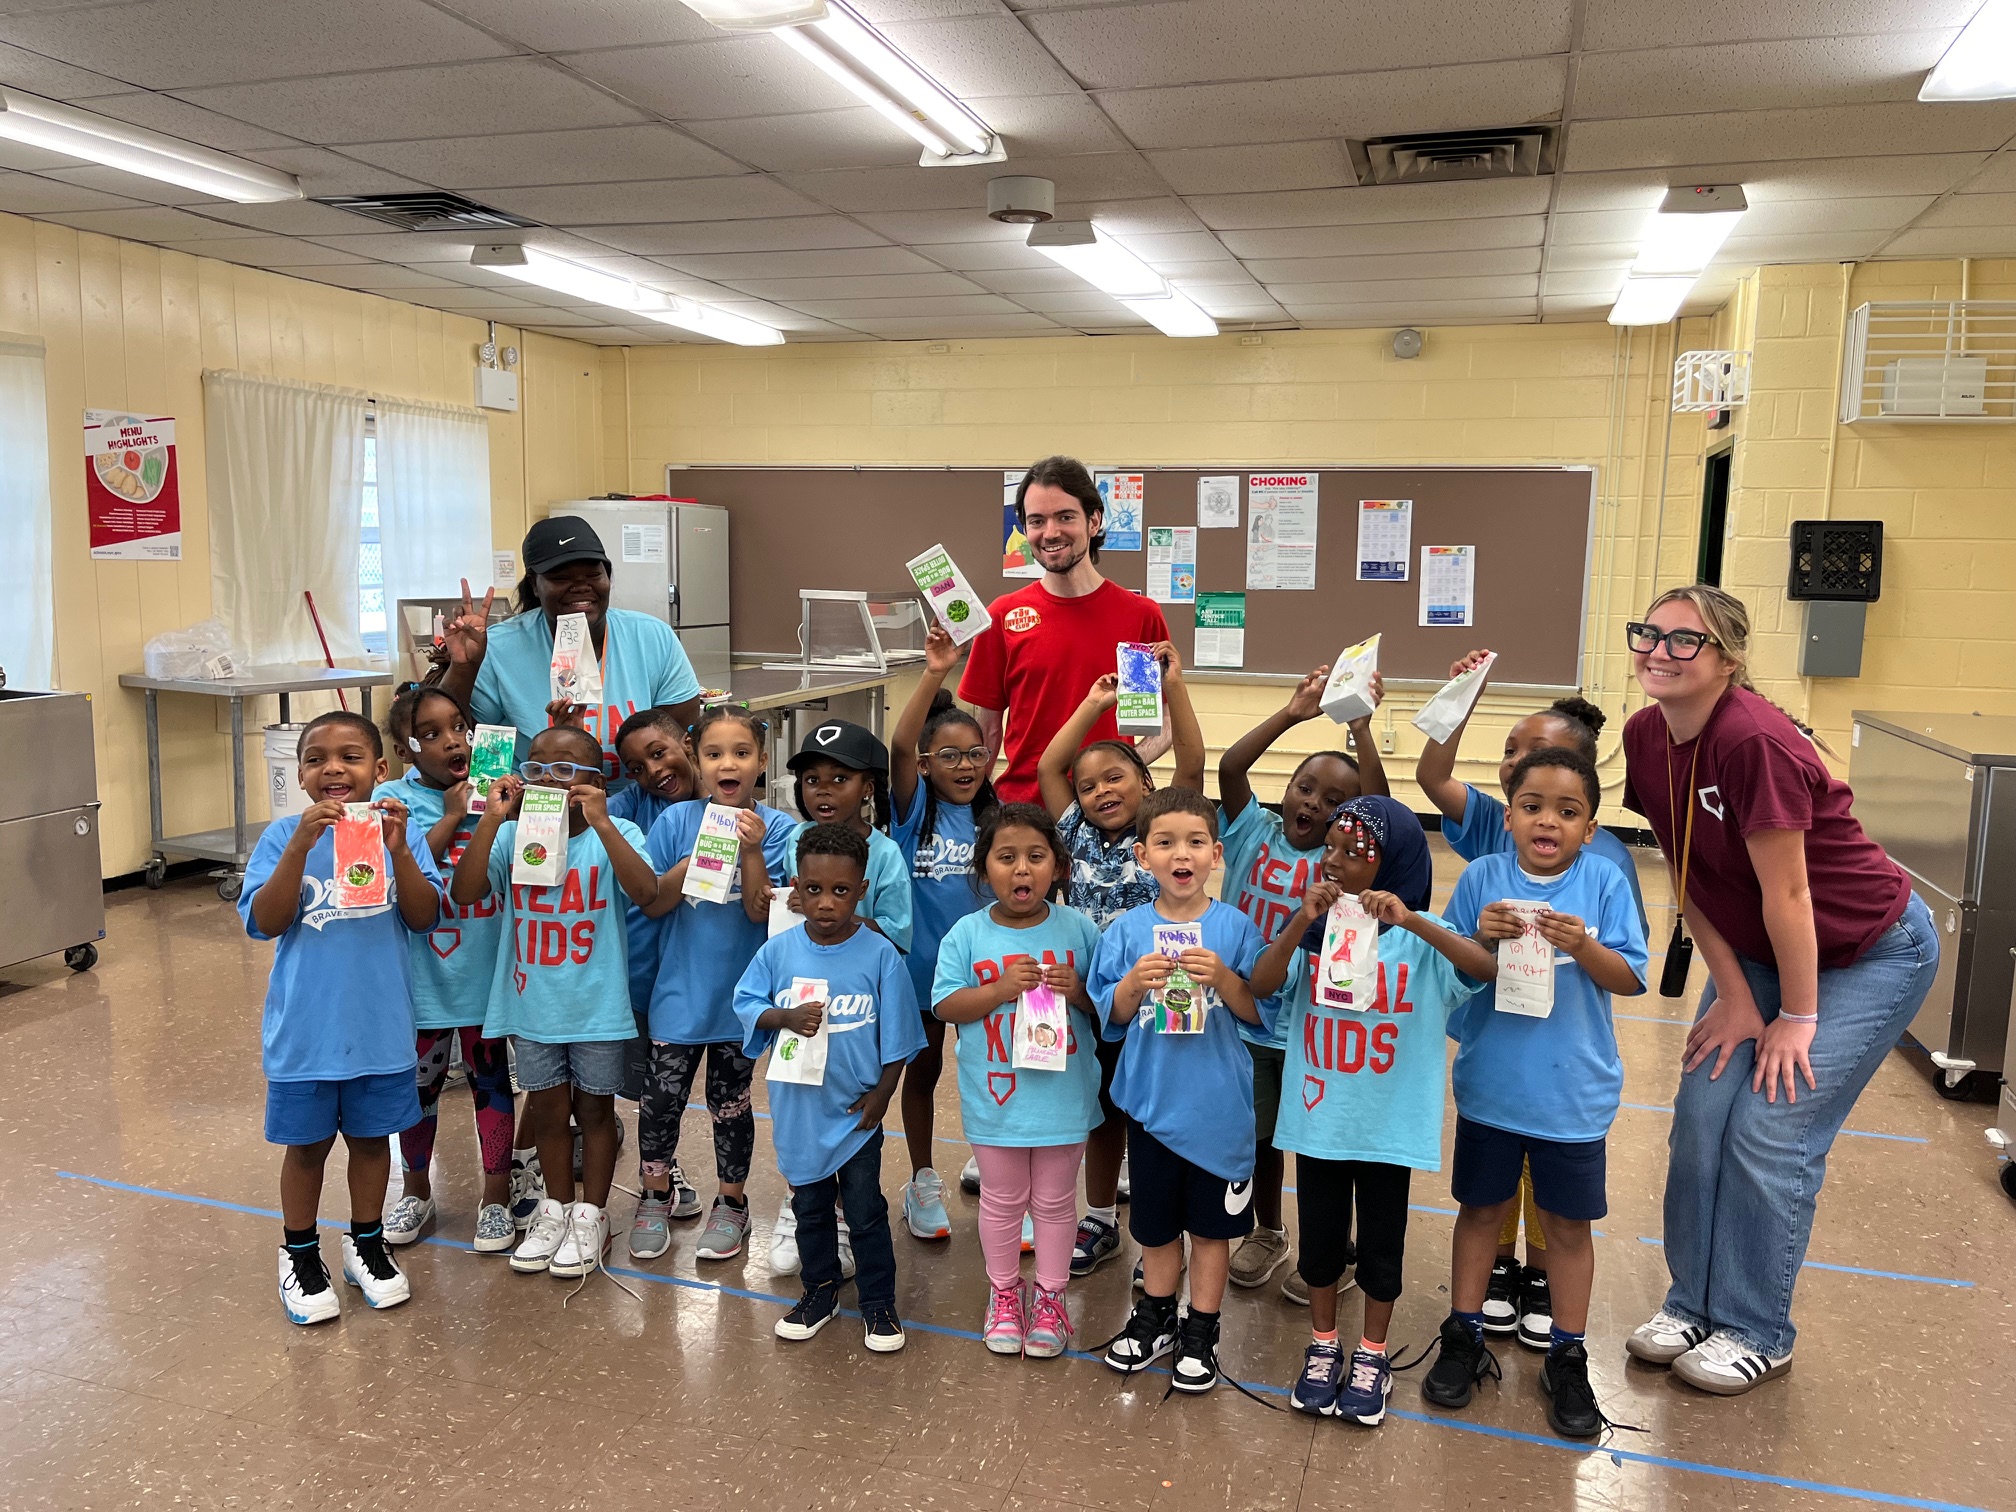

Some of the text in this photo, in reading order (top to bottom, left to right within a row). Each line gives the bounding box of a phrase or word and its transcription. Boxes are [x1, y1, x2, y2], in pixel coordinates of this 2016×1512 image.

[120, 427, 142, 437] MENU
[108, 436, 158, 450] HIGHLIGHTS
[1250, 477, 1307, 486] CHOKING
[914, 563, 930, 576] SPACE
[918, 575, 931, 586] BAG
[934, 582, 950, 593] NYC
[1004, 614, 1041, 630] INVENTORS
[1120, 698, 1132, 706] BUG
[1120, 708, 1155, 717] OUTER SPACE
[525, 803, 542, 811] OUTER
[699, 839, 713, 848] BUG
[722, 843, 735, 852] BAG
[716, 853, 733, 863] SPACE
[1238, 890, 1291, 944] KID
[1329, 990, 1348, 1001] NYC
[1303, 1012, 1399, 1075] KIDS
[636, 1220, 663, 1231] FILA
[707, 1222, 733, 1233] FILA
